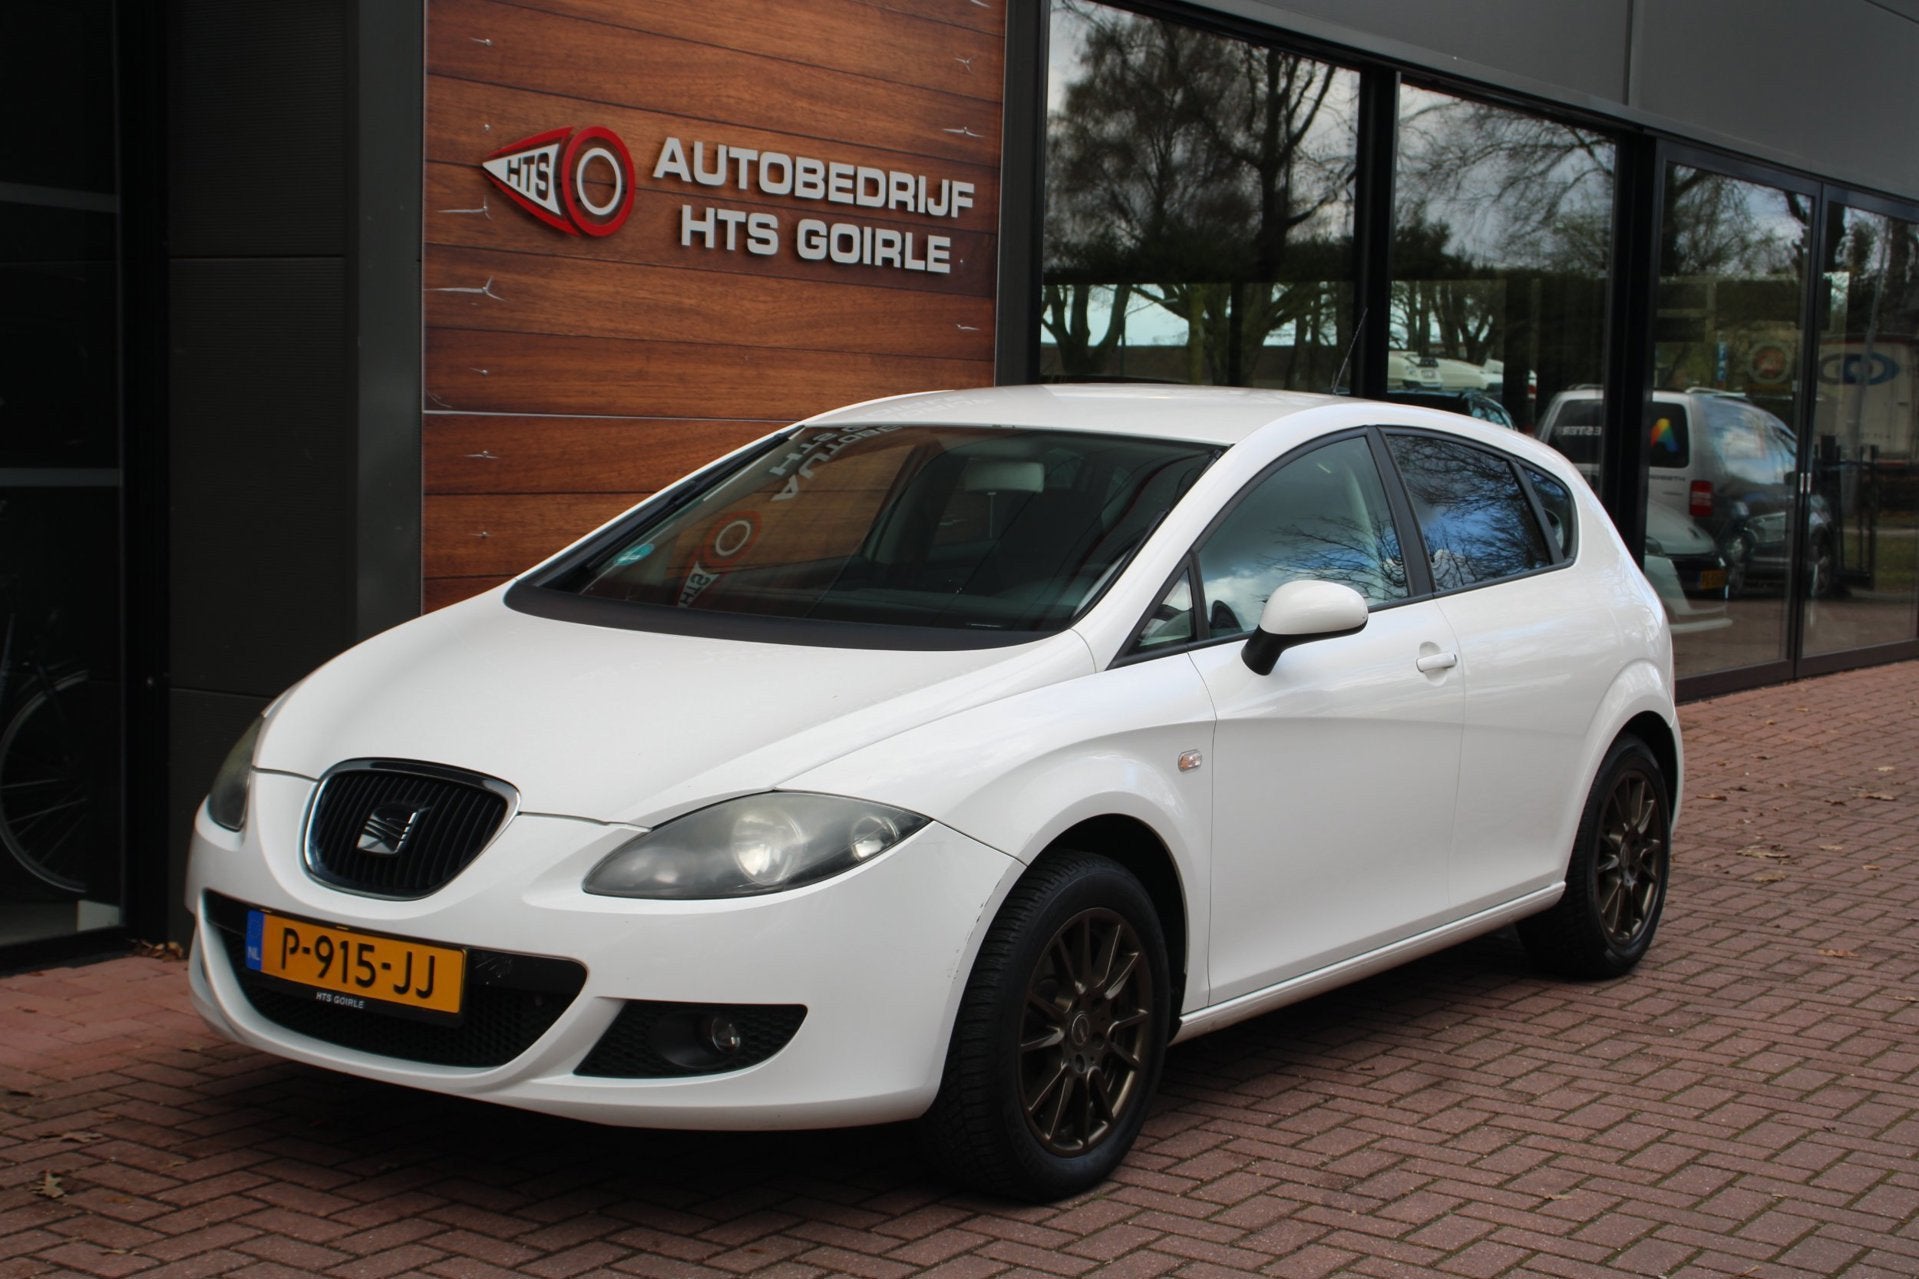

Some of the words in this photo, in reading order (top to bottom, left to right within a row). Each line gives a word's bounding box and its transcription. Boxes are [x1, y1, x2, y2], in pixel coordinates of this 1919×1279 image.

[507, 152, 550, 201] HTS
[652, 136, 975, 218] AUTOBEDRIJF
[681, 204, 779, 256] HTS
[797, 218, 951, 274] GOIRLE
[247, 946, 260, 961] NL
[281, 927, 435, 999] P-915-JJ
[315, 991, 332, 1002] HTS
[333, 995, 365, 1009] GOIRLE
